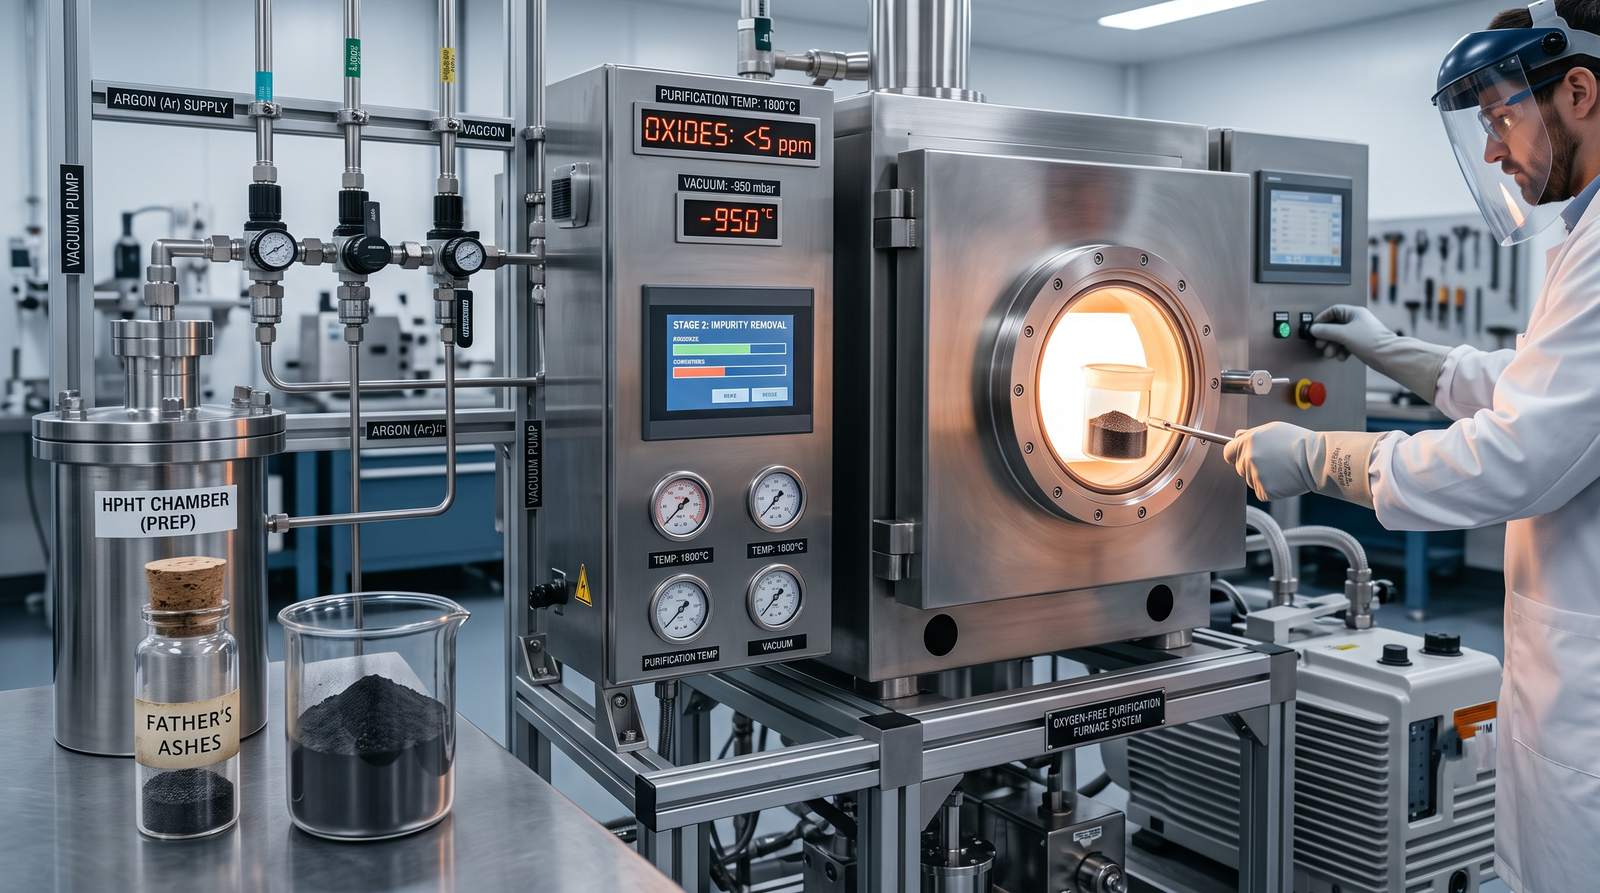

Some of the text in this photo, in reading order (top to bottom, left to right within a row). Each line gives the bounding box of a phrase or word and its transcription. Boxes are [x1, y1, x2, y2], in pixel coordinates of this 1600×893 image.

[113, 92, 229, 114] ARGON (Ar) SUPPLY
[660, 88, 796, 111] PURIFICATION TEMP: 1800°C
[644, 116, 812, 157] OXIDES: <5 ppm
[683, 177, 776, 194] VACUUM: -950 mbar
[65, 172, 80, 267] VACUUM PUMP
[700, 207, 759, 234] -950
[673, 320, 788, 330] STAGE 2: IMPURITY REMOVAL
[371, 424, 411, 437] ARGON
[527, 424, 539, 505] VACUUM PUMP
[102, 491, 230, 512] HPHT CHAMBER
[140, 513, 196, 534] (PREP)
[653, 550, 709, 565] TEMP: 1800°C
[751, 541, 804, 555] TEMP: 1800°C
[762, 639, 793, 651] VACUUM
[644, 649, 718, 668] PURIFICATION TEMP
[147, 706, 232, 732] FATHER'S
[1053, 697, 1161, 729] OXYGEN-FREE PURIFICATION
[1073, 713, 1142, 737] FURNACE SYSTEM
[157, 733, 221, 756] ASHES
